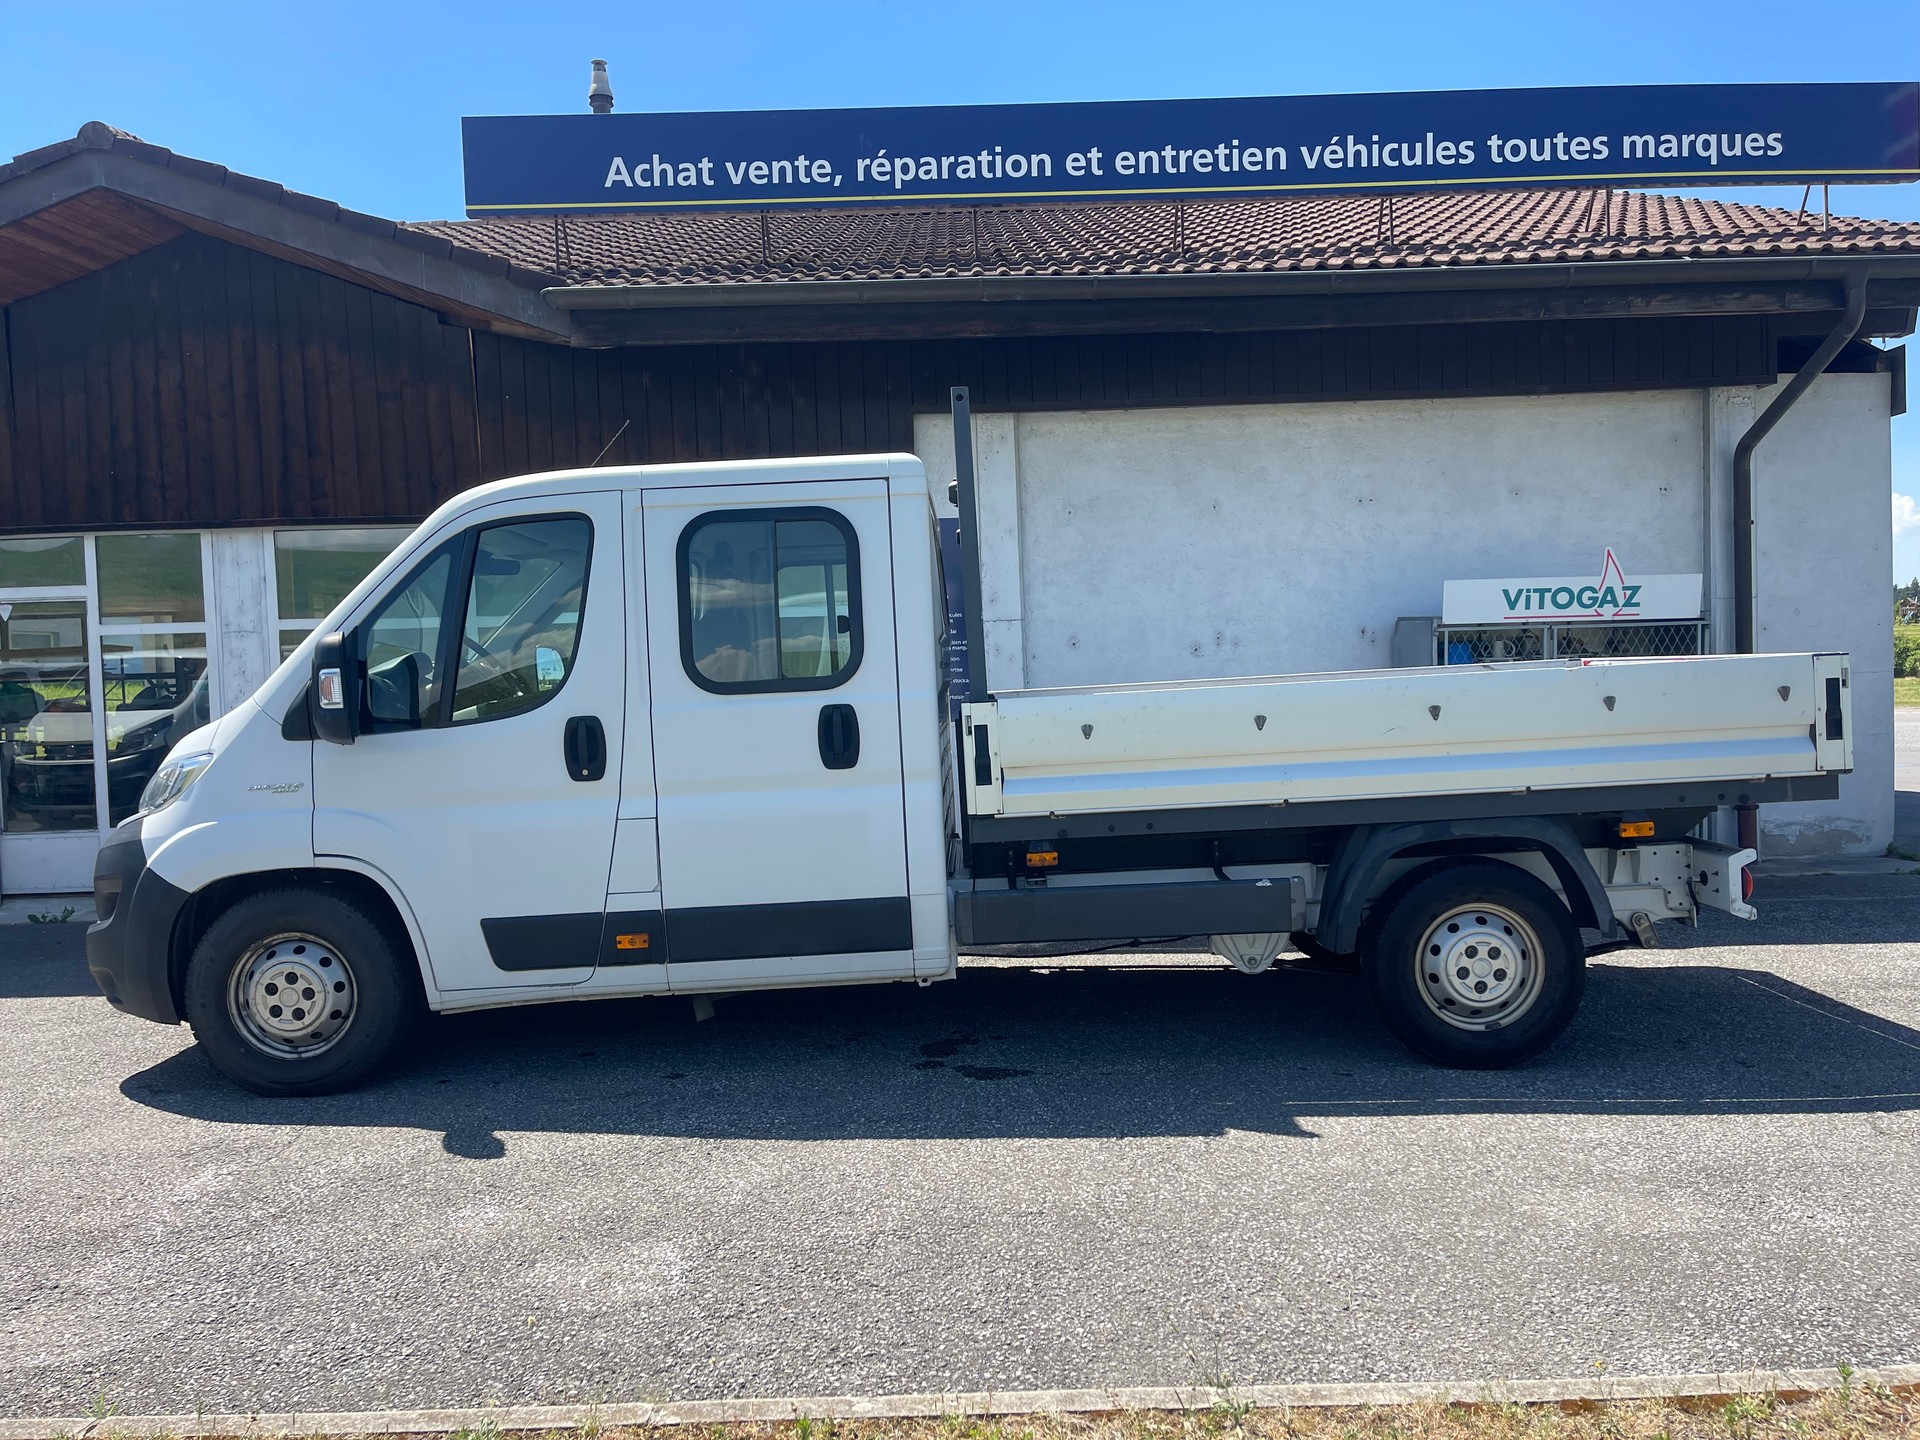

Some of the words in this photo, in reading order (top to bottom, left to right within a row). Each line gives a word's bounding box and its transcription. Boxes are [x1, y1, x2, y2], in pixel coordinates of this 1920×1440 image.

[604, 153, 715, 188] Achat
[724, 154, 843, 187] vente,
[857, 145, 1052, 190] réparation
[1065, 146, 1104, 177] et
[1114, 139, 1287, 175] entretien
[1299, 132, 1475, 169] véhicules
[1486, 131, 1609, 163] toutes
[1623, 132, 1783, 165] marques
